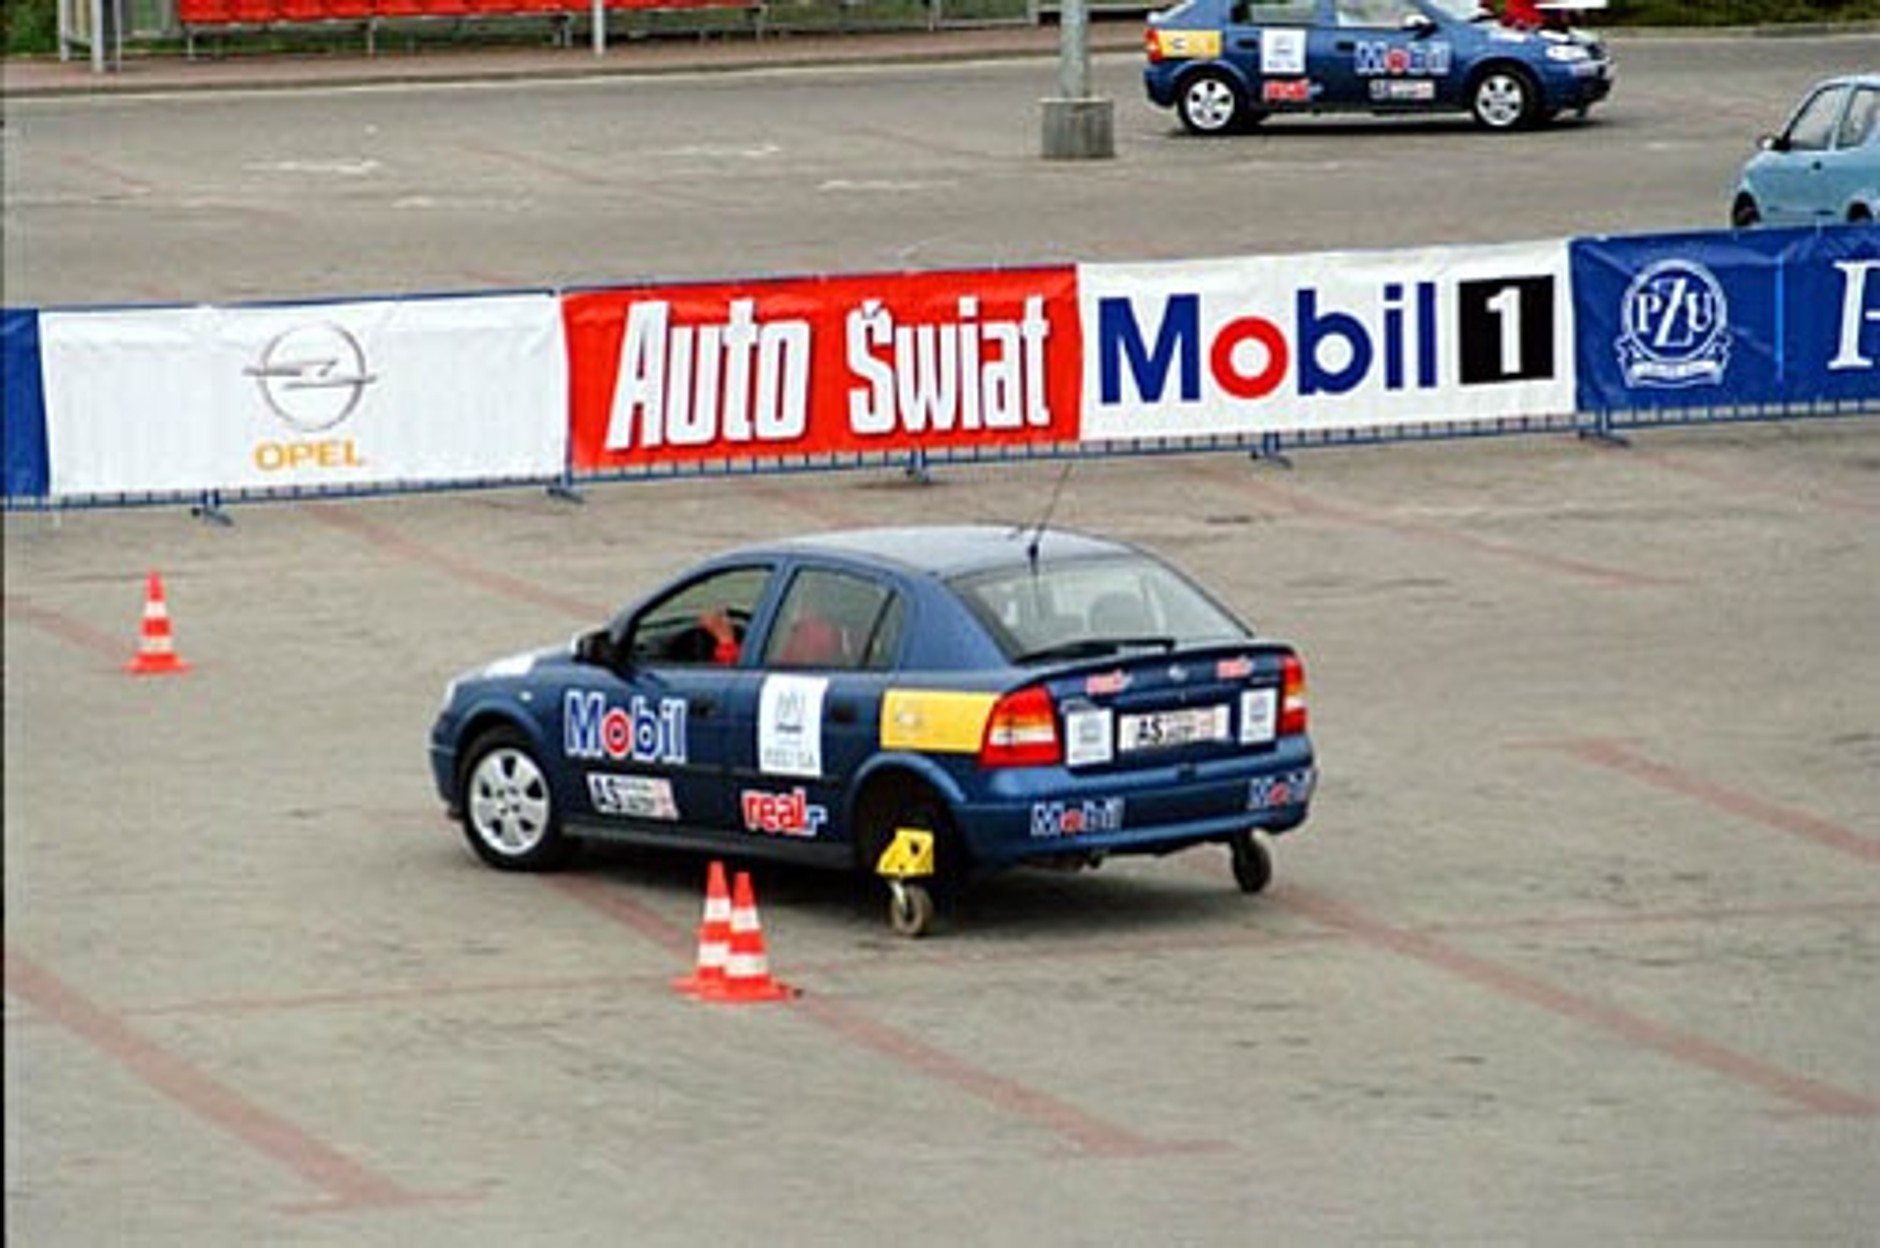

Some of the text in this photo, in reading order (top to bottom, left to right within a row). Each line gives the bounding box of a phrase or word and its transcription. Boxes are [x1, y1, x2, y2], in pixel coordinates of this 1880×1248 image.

[1097, 282, 1523, 406] Mobil 1
[1634, 277, 1713, 348] PZU
[605, 294, 1050, 450] Auto Świat
[255, 437, 366, 473] OPEL
[563, 689, 688, 764] Mobil
